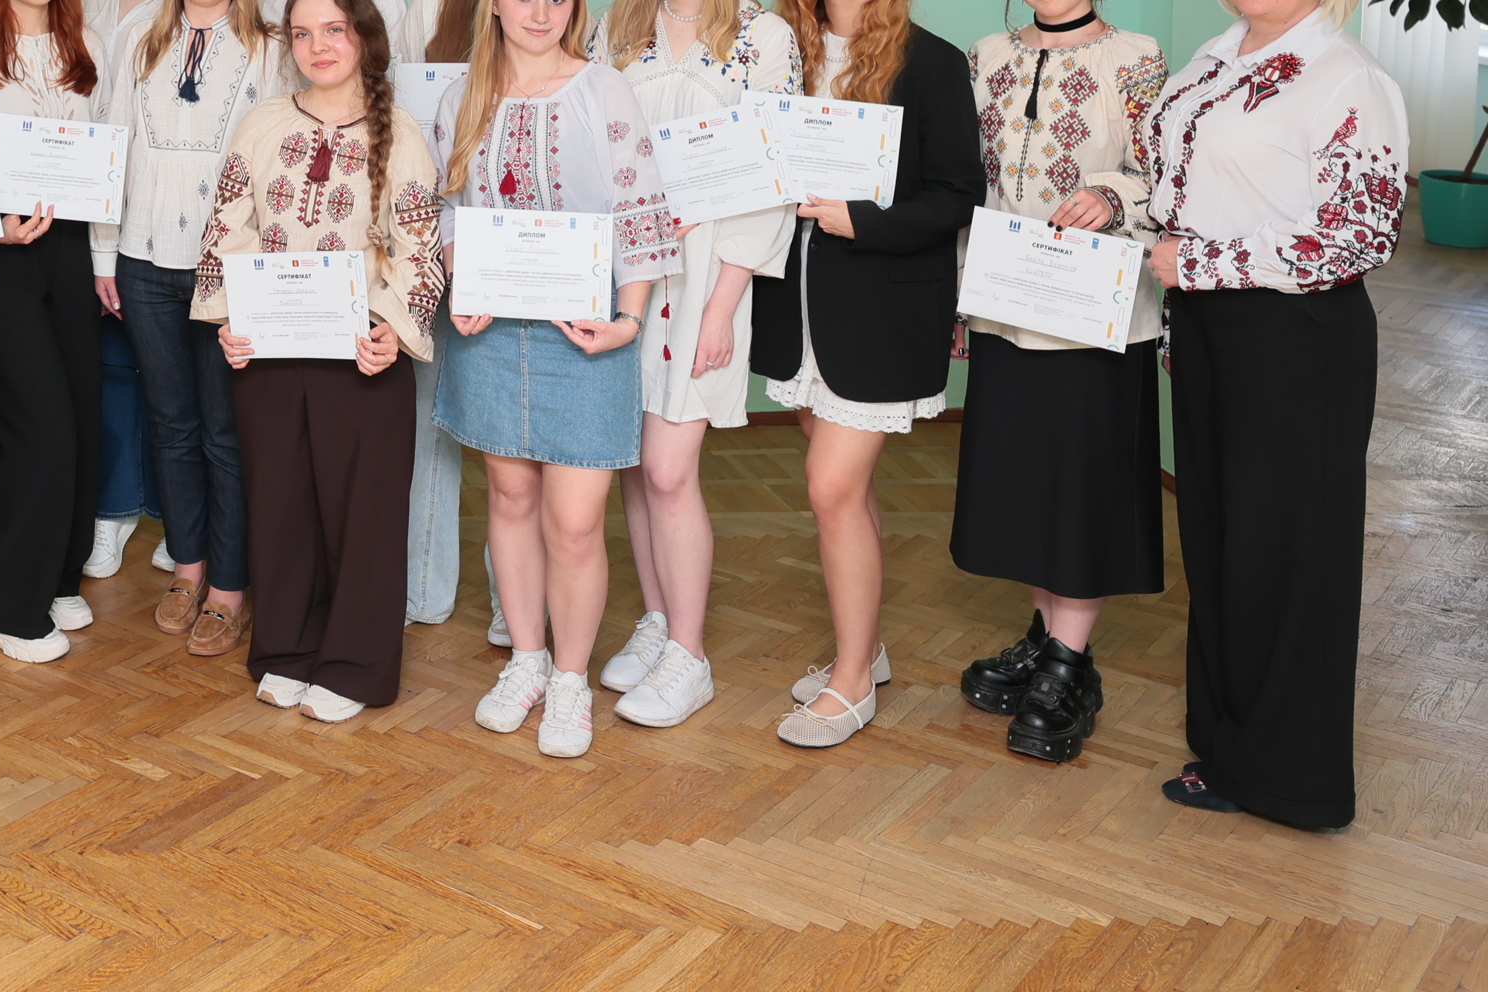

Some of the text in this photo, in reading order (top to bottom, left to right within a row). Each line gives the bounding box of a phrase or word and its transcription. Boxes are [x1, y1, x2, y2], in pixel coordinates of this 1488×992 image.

[803, 118, 832, 126] ДИПЛОМ
[41, 138, 75, 146] СЕРТИФІКАТ
[688, 133, 714, 145] ДИПЛОМ
[518, 231, 546, 239] ДИПЛОМ
[1031, 241, 1074, 256] СЕРТИФІКАТ
